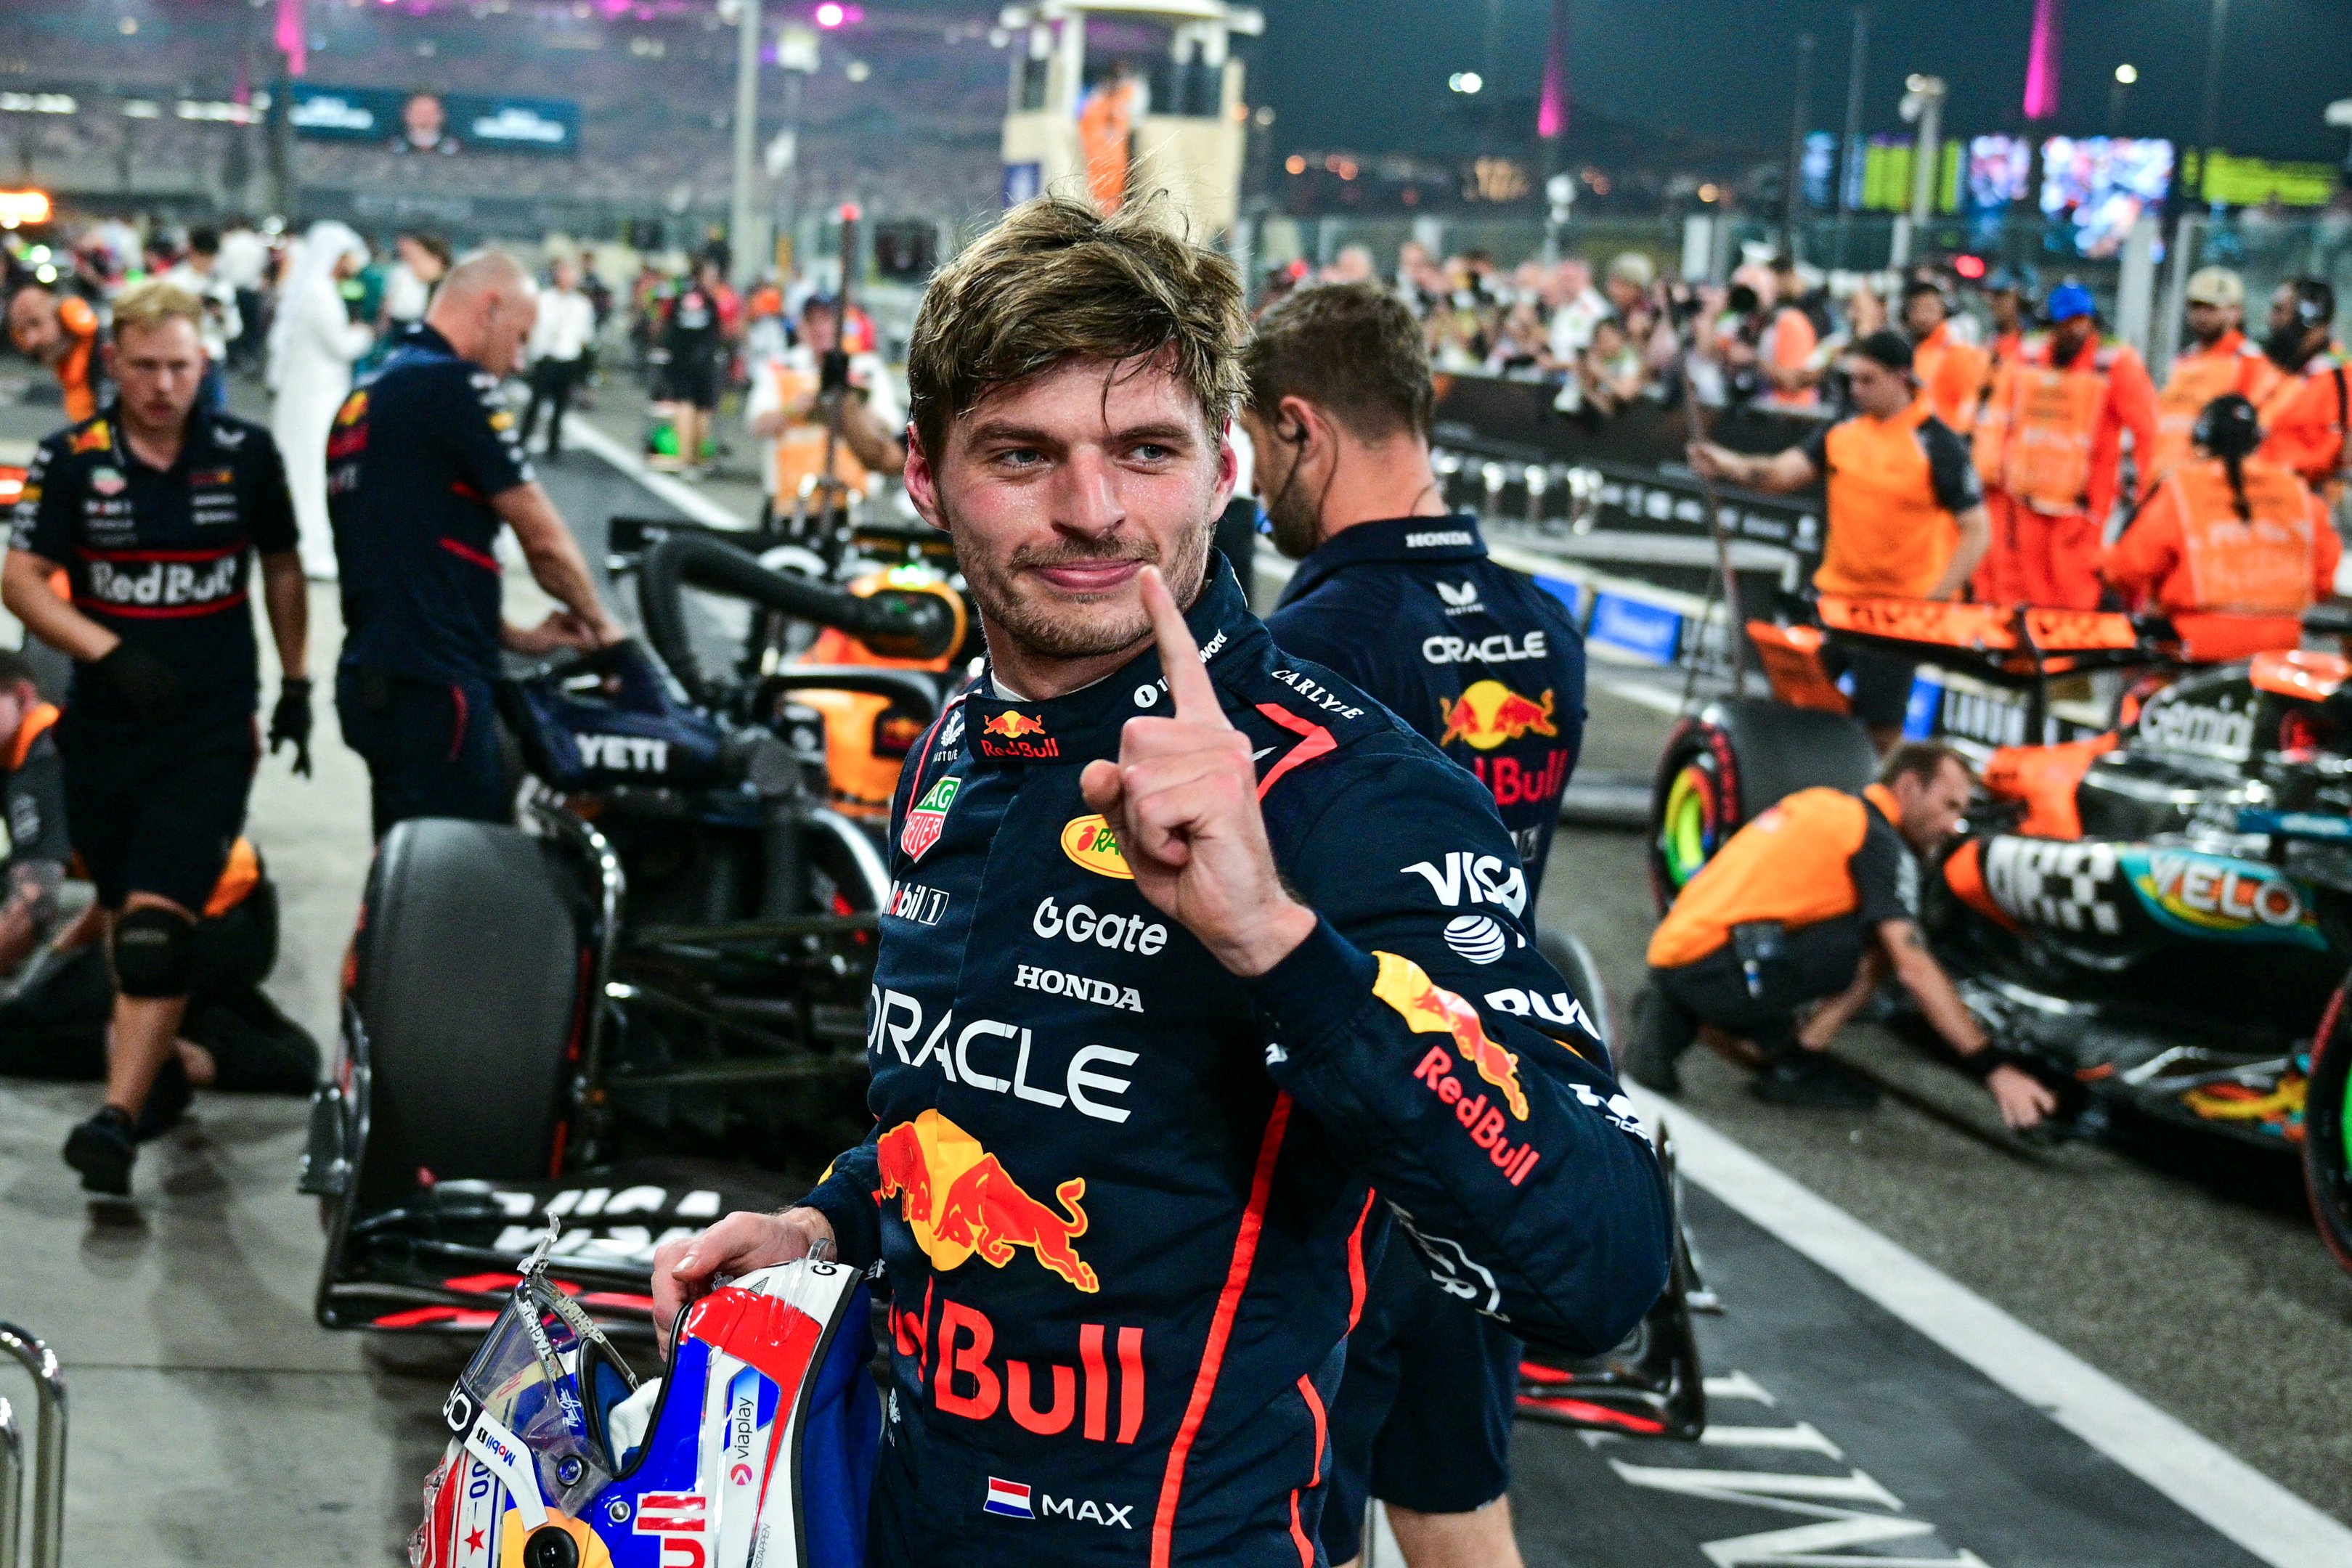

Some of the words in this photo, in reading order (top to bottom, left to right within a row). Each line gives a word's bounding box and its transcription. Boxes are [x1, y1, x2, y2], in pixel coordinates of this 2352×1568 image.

[1406, 531, 1473, 548] HONDA
[1422, 630, 1548, 664] ORACLE
[1271, 669, 1365, 719] CARLYLE
[577, 735, 667, 773] YETI
[1400, 851, 1528, 919] VISA
[2149, 851, 2303, 926] VELO
[1065, 903, 1168, 956] Gate
[1013, 964, 1144, 1013] HONDA
[934, 1298, 1146, 1445] Bull
[486, 1435, 516, 1467] Mobil
[735, 1397, 754, 1460] viaplay
[633, 1495, 706, 1568] ull
[1042, 1494, 1134, 1530] MAX
